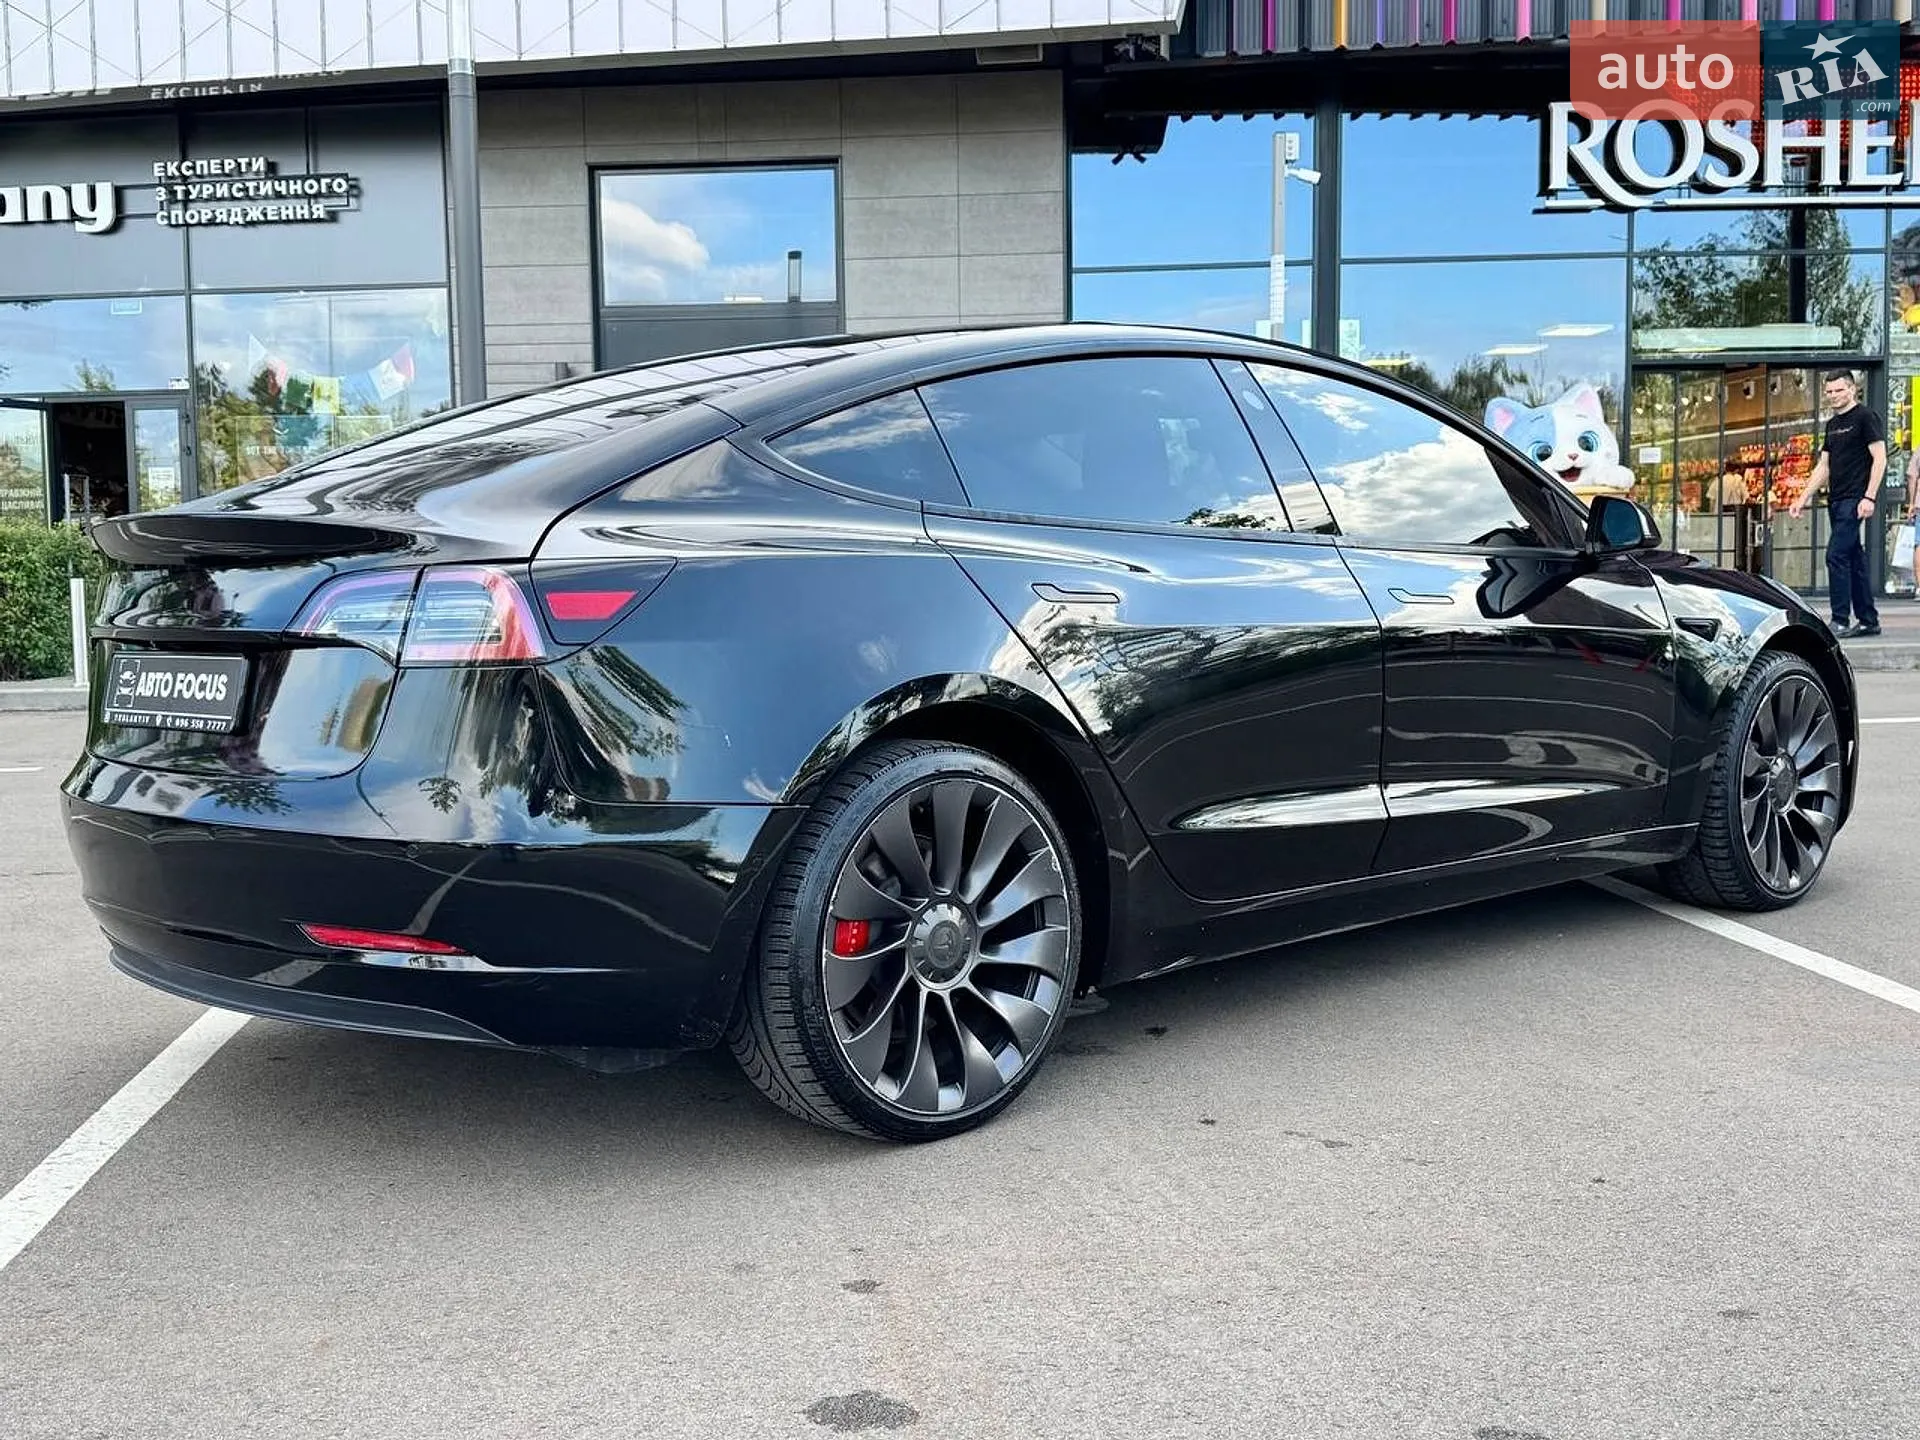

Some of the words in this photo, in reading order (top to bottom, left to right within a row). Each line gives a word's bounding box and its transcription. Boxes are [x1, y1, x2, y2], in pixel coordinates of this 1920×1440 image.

[153, 157, 265, 177] ЕКСПЕРТИ
[174, 178, 348, 201] ТУРИСТИЧНОГО
[156, 204, 325, 226] СПОРЯДЖЕННЯ
[173, 672, 228, 701] FOCUS
